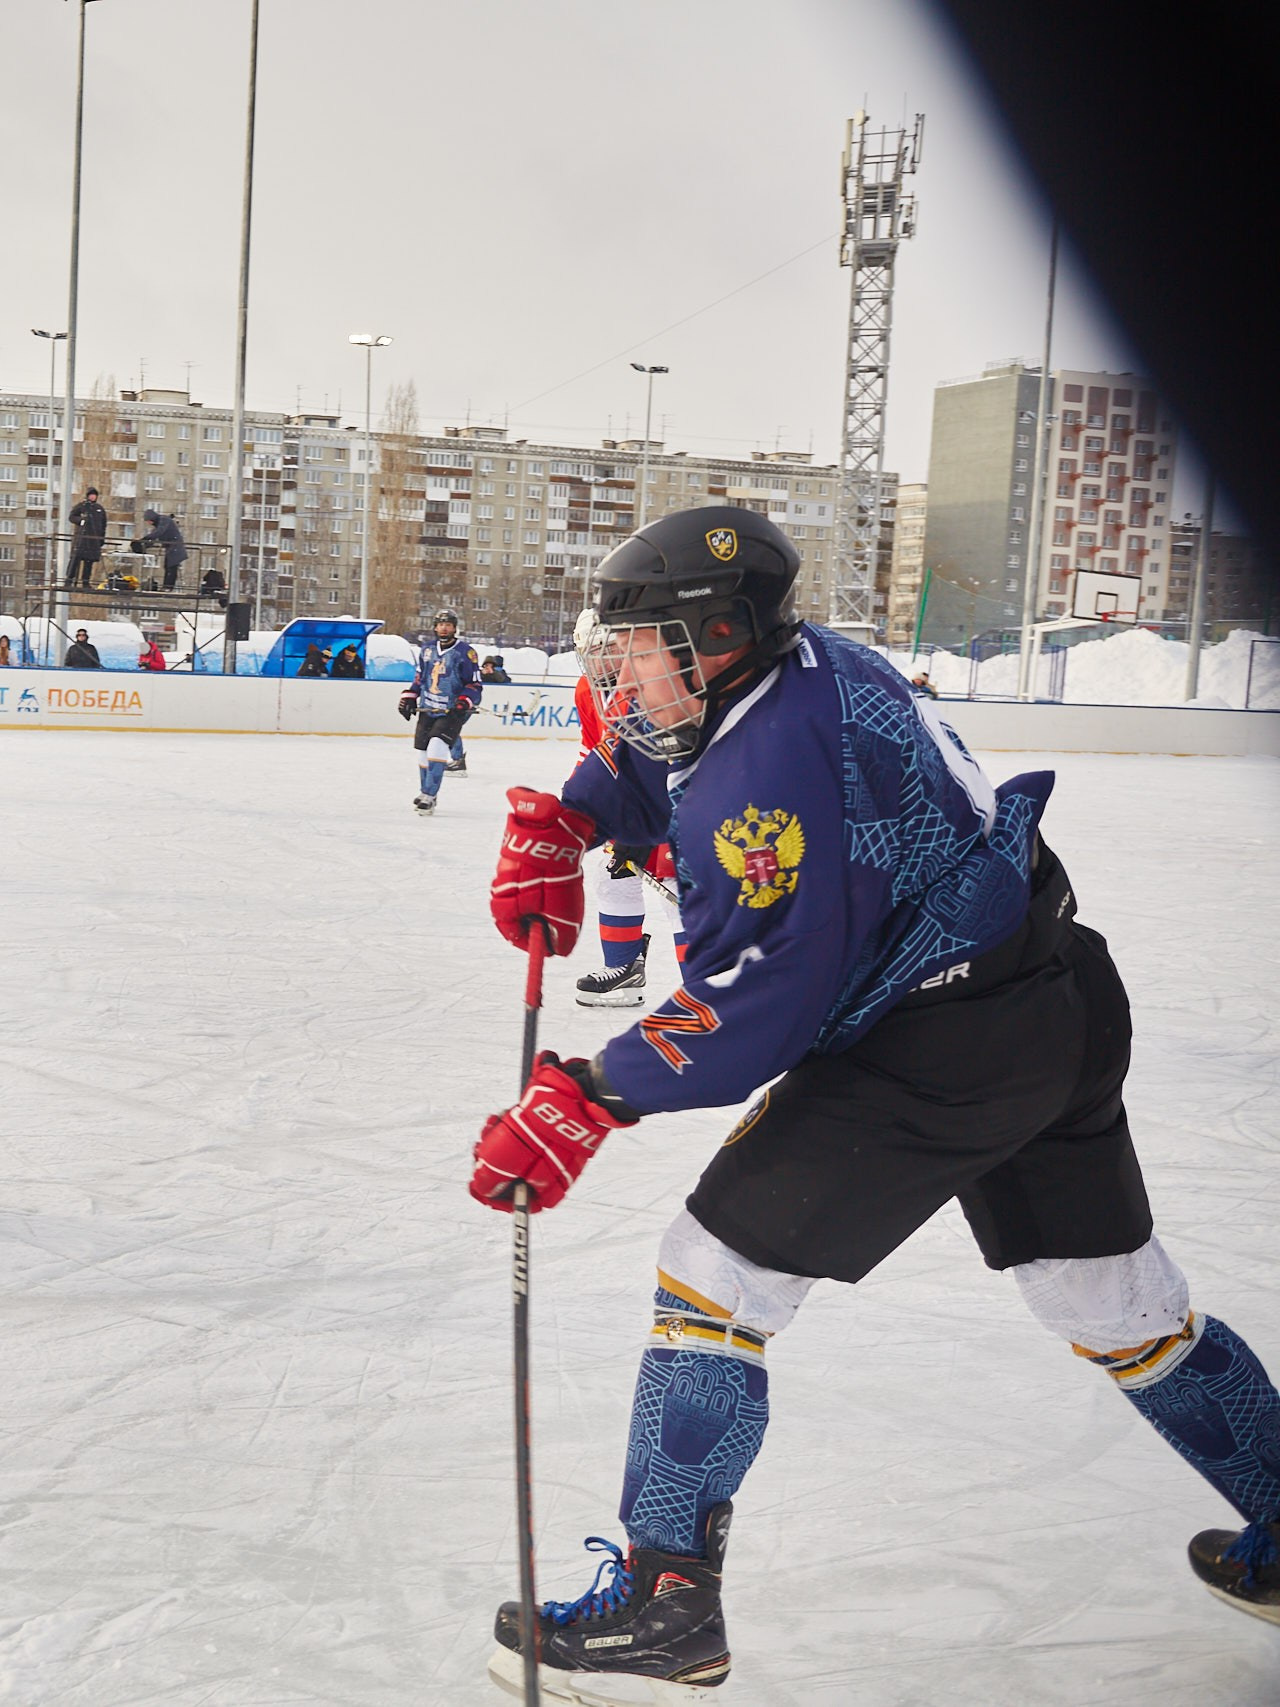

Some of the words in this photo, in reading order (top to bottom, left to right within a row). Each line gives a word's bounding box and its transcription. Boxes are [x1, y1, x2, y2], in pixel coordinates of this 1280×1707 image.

[677, 586, 713, 600] Reebok
[47, 688, 144, 713] ПОБЕДА
[586, 1636, 631, 1648] BAUER
